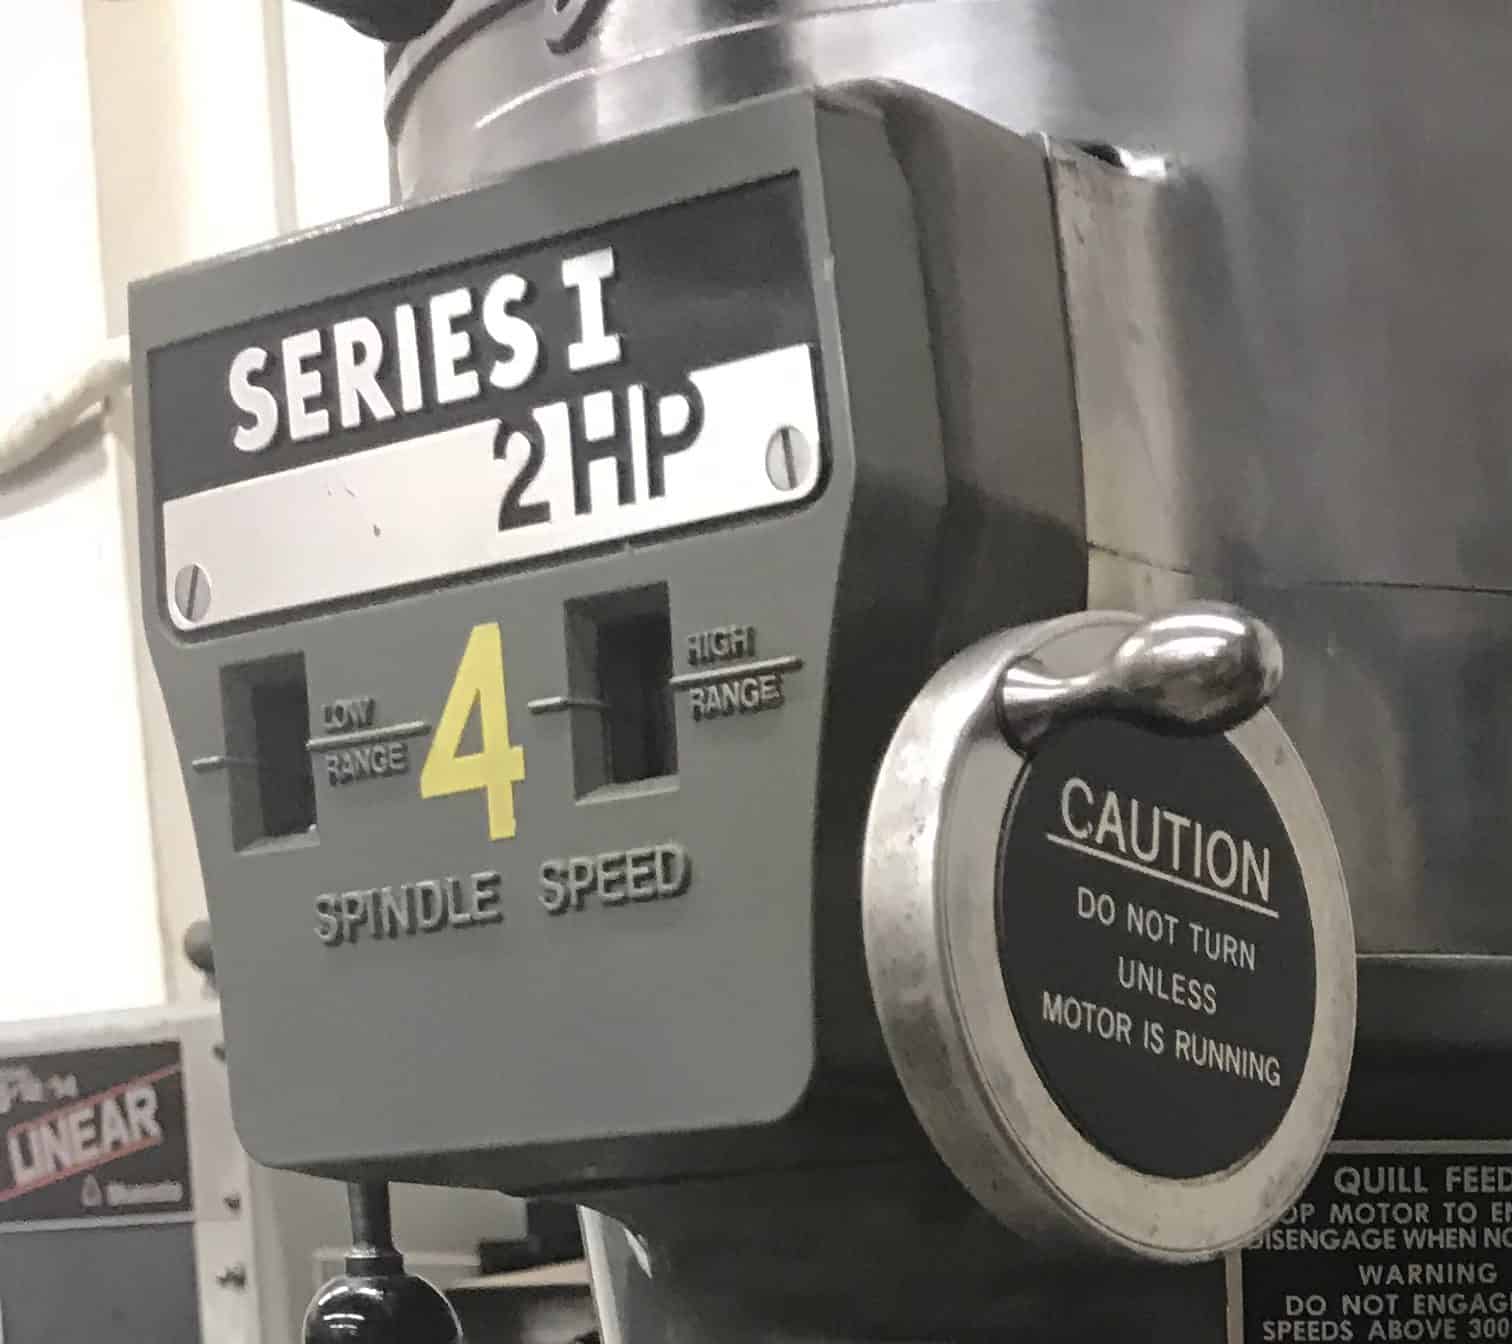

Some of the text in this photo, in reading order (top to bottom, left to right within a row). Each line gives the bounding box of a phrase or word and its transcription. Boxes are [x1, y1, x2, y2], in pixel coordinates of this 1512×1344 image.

[228, 246, 622, 454] SERIES I
[492, 381, 706, 533] 2HP
[687, 624, 757, 667] HIGH
[322, 698, 376, 737] LOW
[688, 673, 784, 723] RANGE
[418, 621, 527, 842] 4
[325, 743, 409, 790] RANGE
[1060, 776, 1271, 902] CAUTION
[313, 840, 692, 947] SPINDLE SPEED
[1077, 886, 1257, 971] DO NOT TURN
[1117, 956, 1217, 1016] UNLESS
[1042, 990, 1282, 1087] MOTOR IS RUNNING
[1333, 1165, 1429, 1197] QUILL
[1329, 1201, 1430, 1225] MOTOR
[1442, 1201, 1479, 1223] TO
[1402, 1227, 1478, 1249] WHEN
[1359, 1262, 1499, 1286] WARNING
[1262, 1319, 1354, 1342] SPEEDS
[1367, 1318, 1457, 1341] ABOVE
[1285, 1295, 1328, 1318] DO
[1342, 1294, 1400, 1317] NOT
